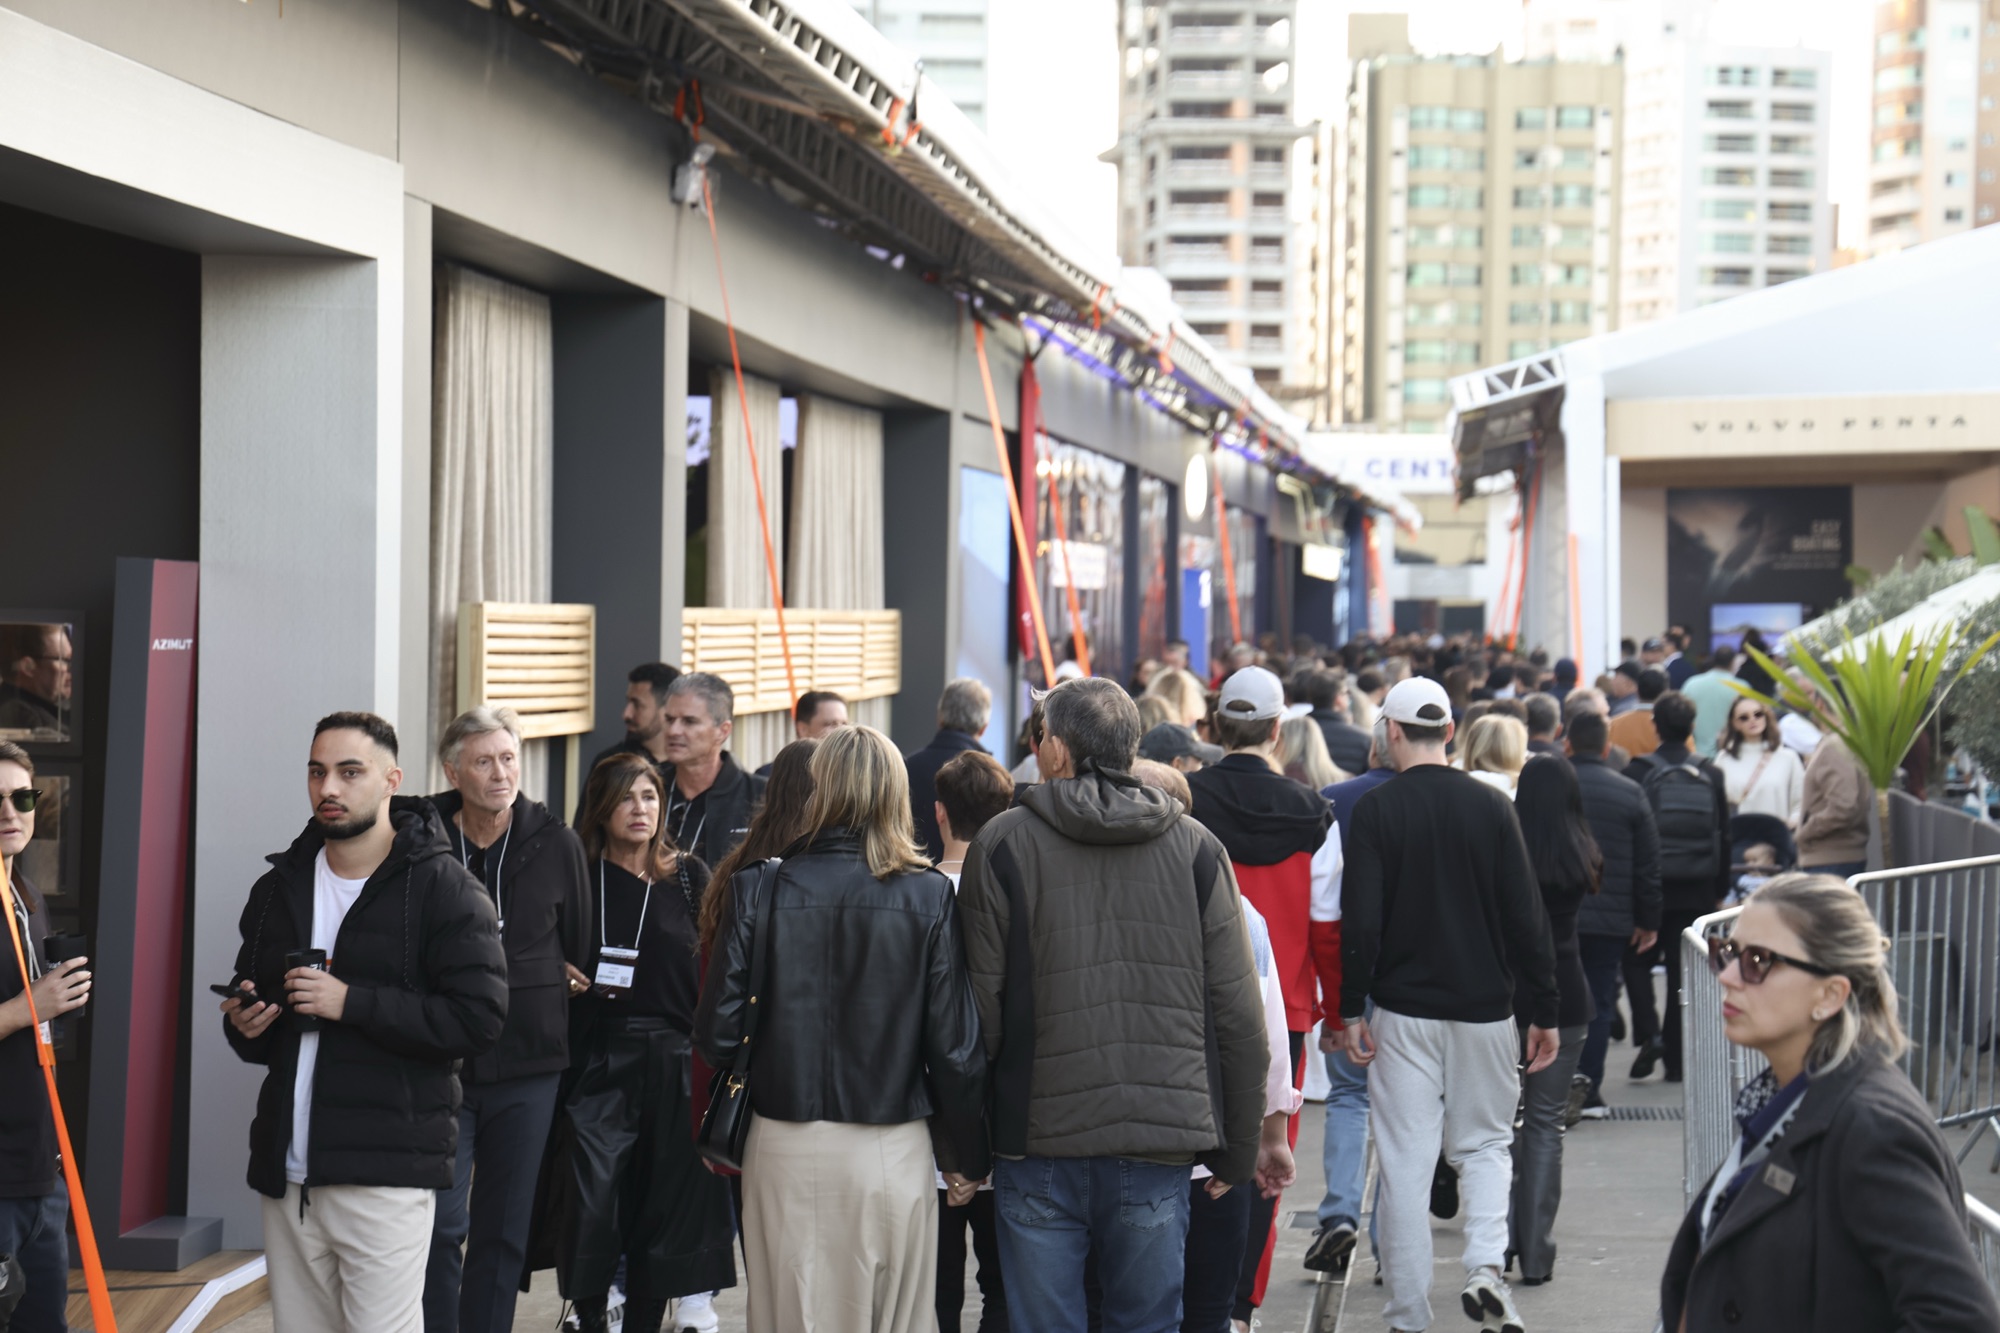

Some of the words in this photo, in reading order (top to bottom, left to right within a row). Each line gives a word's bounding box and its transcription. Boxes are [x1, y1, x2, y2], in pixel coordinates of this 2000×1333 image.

[1691, 418, 1815, 433] VOLVO
[1841, 415, 1967, 431] PENTA
[152, 638, 193, 650] AZIMUT
